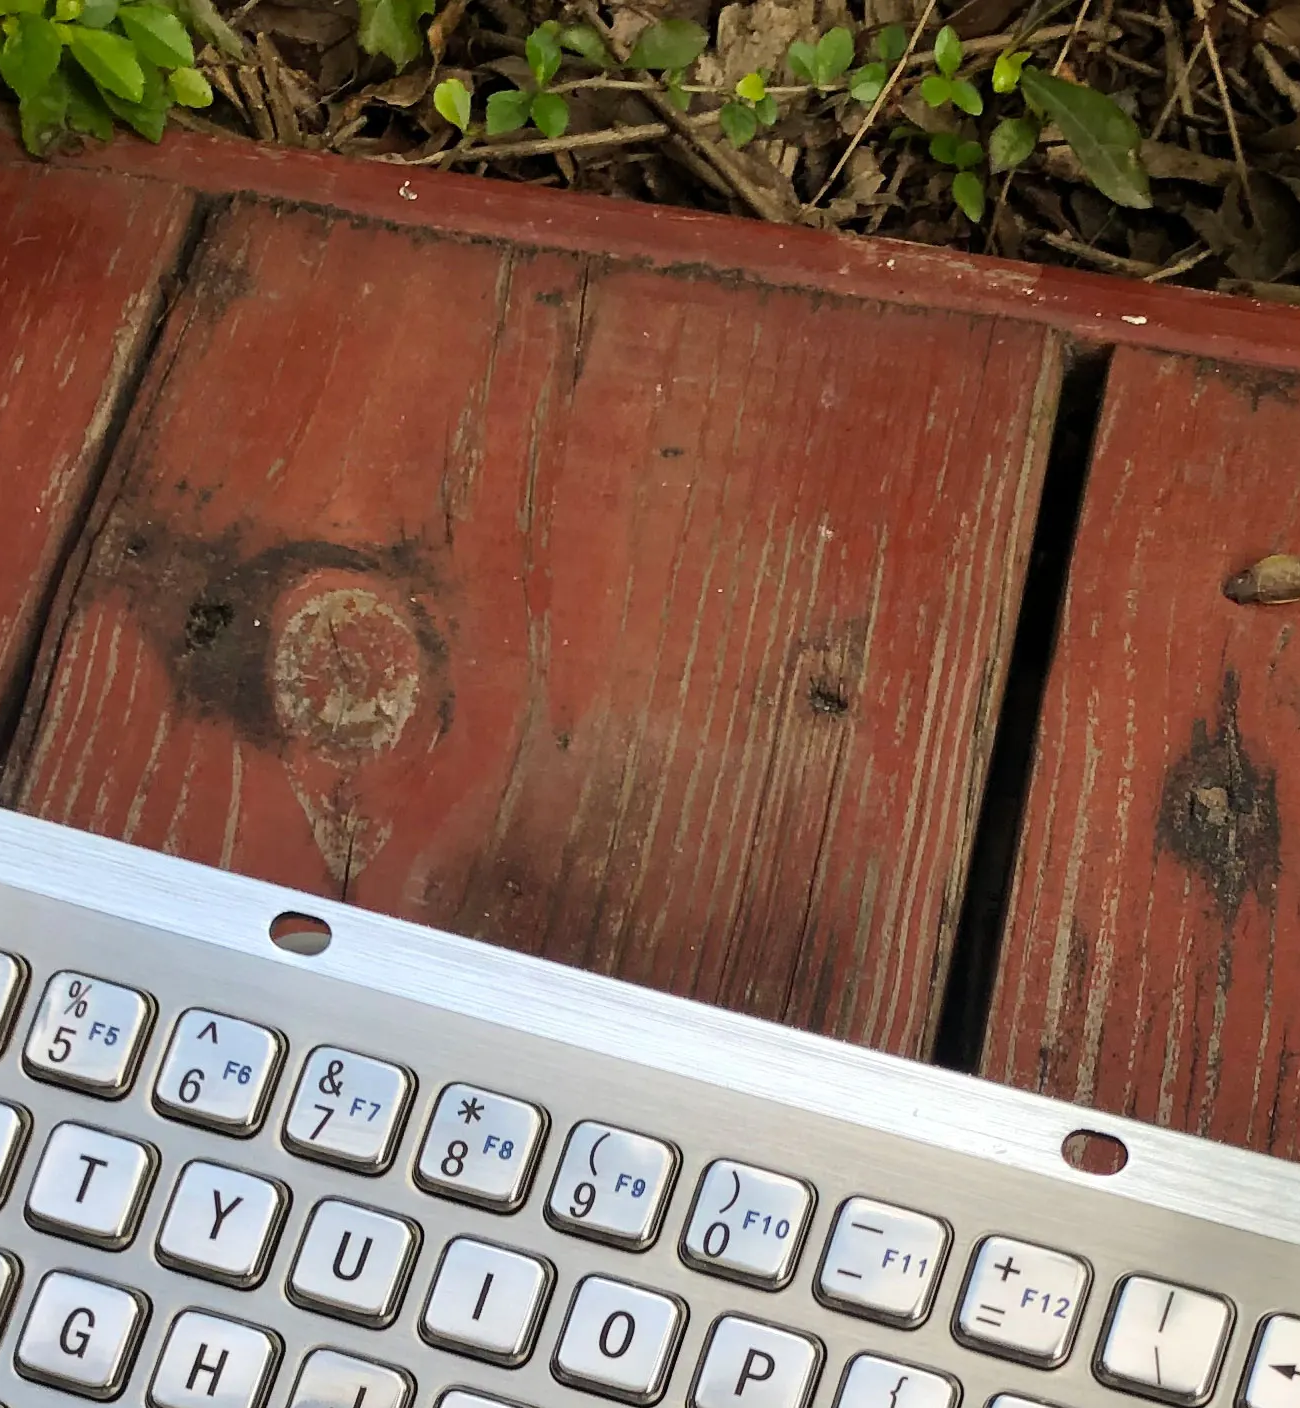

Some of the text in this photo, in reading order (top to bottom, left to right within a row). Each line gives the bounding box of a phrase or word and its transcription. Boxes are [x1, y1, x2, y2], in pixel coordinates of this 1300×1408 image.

[67, 980, 93, 1020] %
[47, 1027, 77, 1064] 5
[87, 1021, 120, 1046] F5
[178, 1067, 206, 1105] 6
[222, 1060, 252, 1085] F6
[317, 1059, 345, 1098] &
[308, 1104, 335, 1141] 7
[348, 1097, 382, 1122] F7
[439, 1139, 468, 1178] 8
[482, 1134, 515, 1161] F8
[74, 1153, 108, 1204] T
[614, 1173, 648, 1199] F9
[207, 1188, 245, 1241] Y
[569, 1181, 598, 1220] 9
[742, 1209, 791, 1240] F10
[331, 1229, 374, 1282] U
[880, 1248, 928, 1280] F11
[993, 1255, 1021, 1283] +
[975, 1303, 1006, 1328] =
[1019, 1288, 1072, 1320] F12
[57, 1307, 96, 1361] G
[184, 1342, 231, 1397] H
[733, 1347, 776, 1397] P
